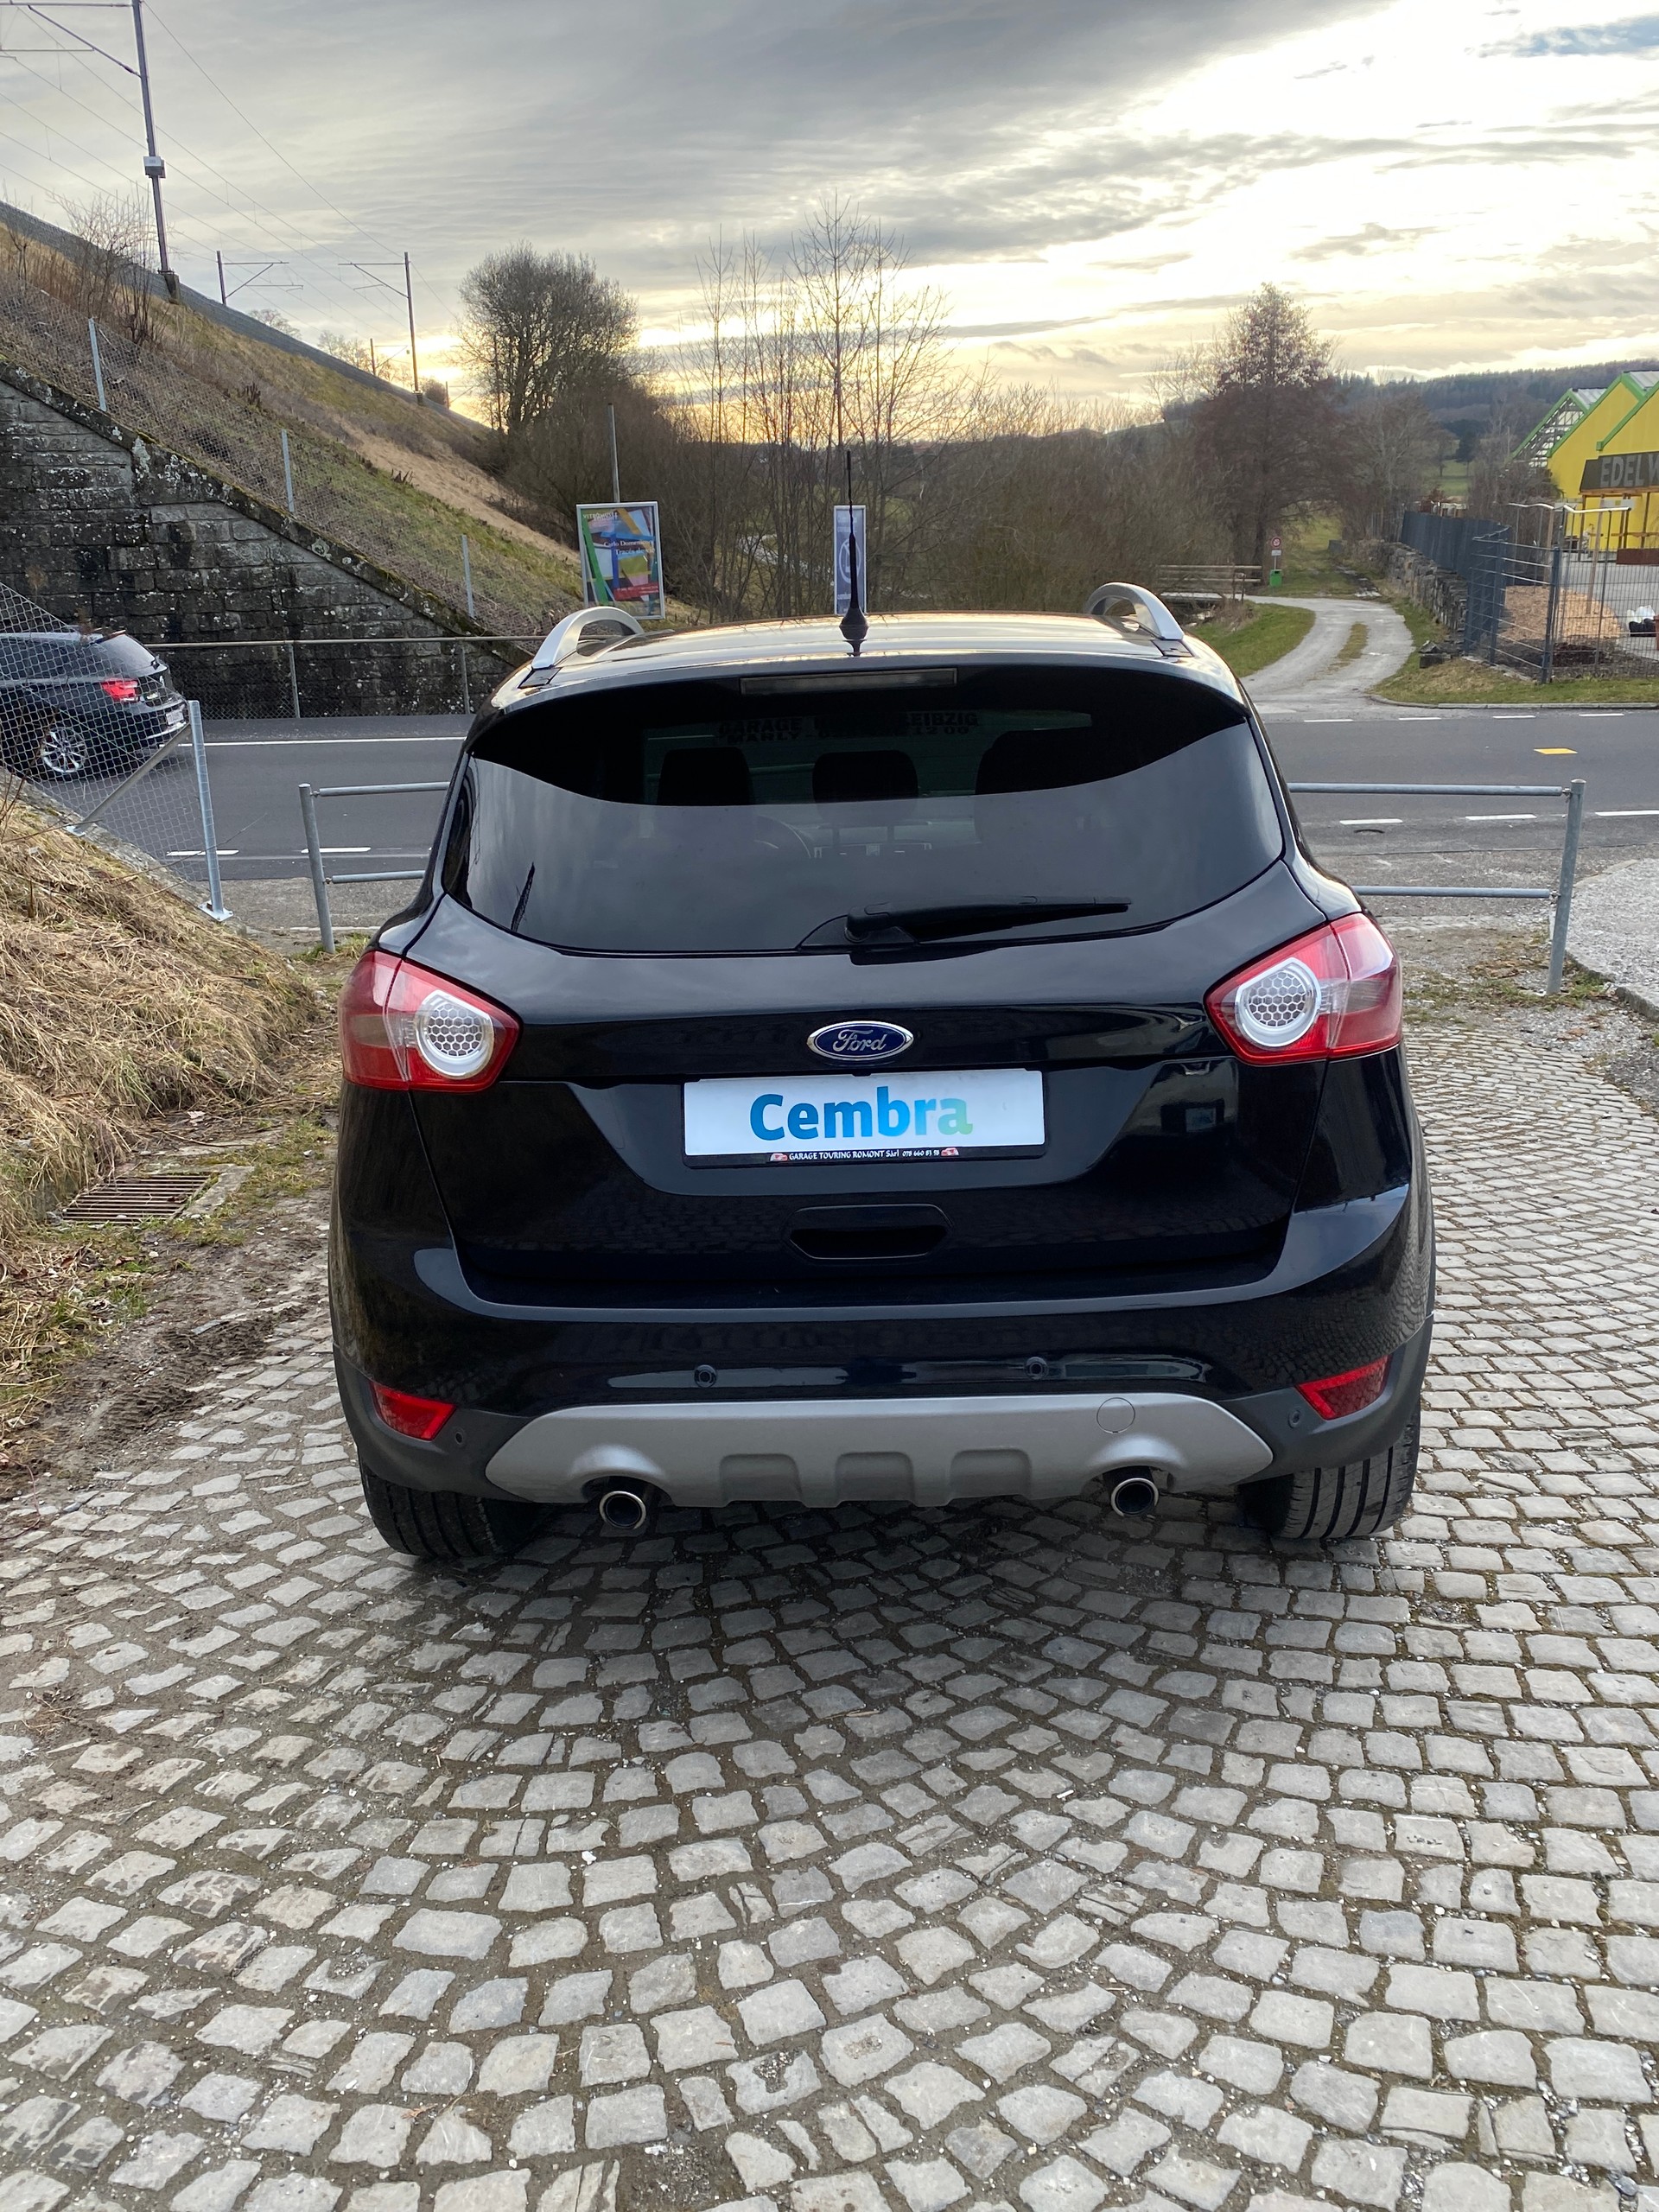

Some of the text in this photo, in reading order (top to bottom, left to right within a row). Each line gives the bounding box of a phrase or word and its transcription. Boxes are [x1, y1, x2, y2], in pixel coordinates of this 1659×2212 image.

[718, 718, 801, 736] GARAGE
[832, 1028, 887, 1052] Ford
[749, 1085, 974, 1141] Cembra
[789, 1152, 818, 1160] GARAGE
[819, 1151, 852, 1160] TOURING
[852, 1150, 885, 1160] ROMONT
